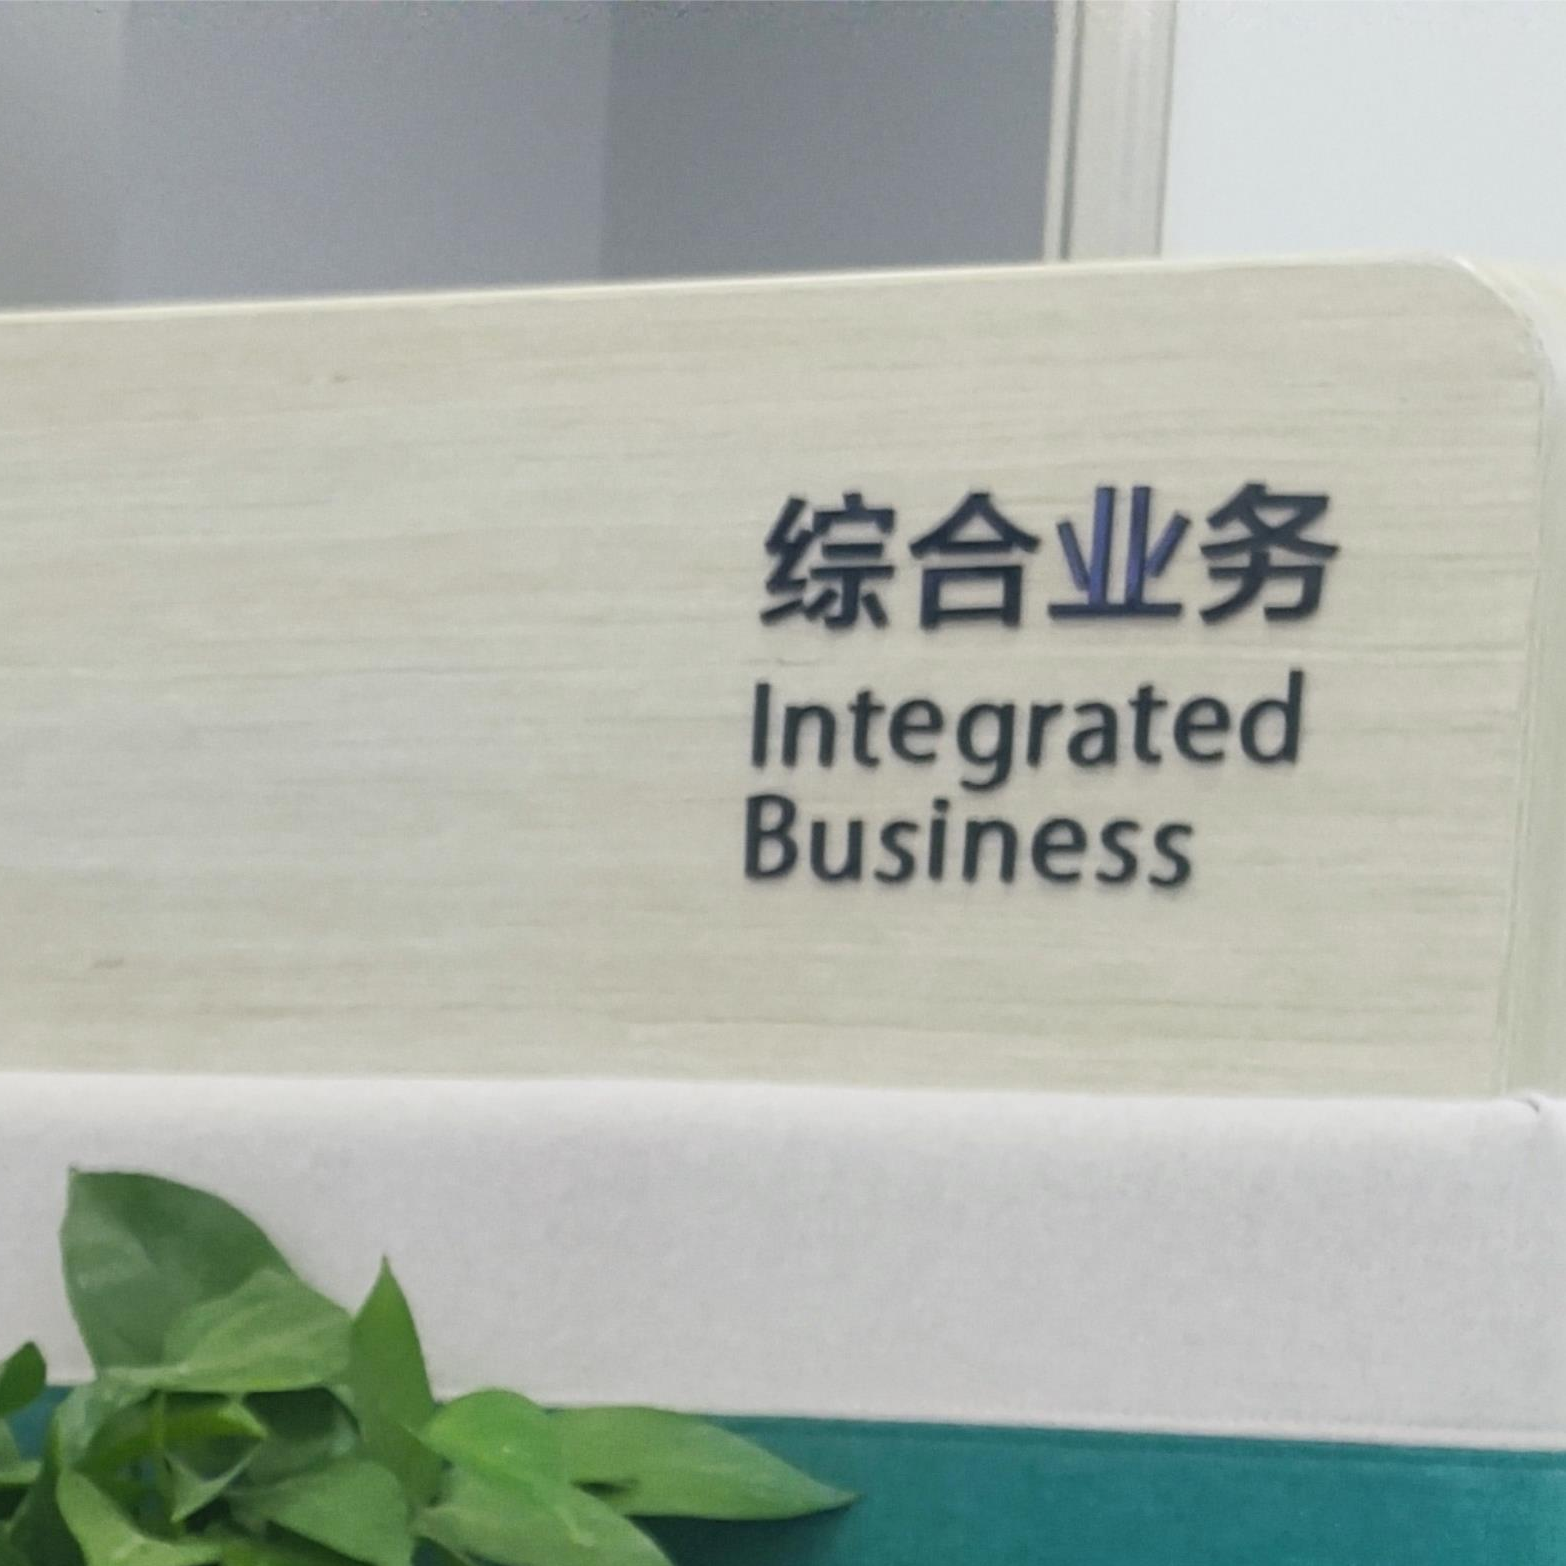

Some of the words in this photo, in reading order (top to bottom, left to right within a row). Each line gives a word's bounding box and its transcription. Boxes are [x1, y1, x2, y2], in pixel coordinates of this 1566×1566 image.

[760, 481, 1341, 631] 综合业务
[749, 669, 1305, 792] Integrated
[743, 794, 1195, 889] Business
